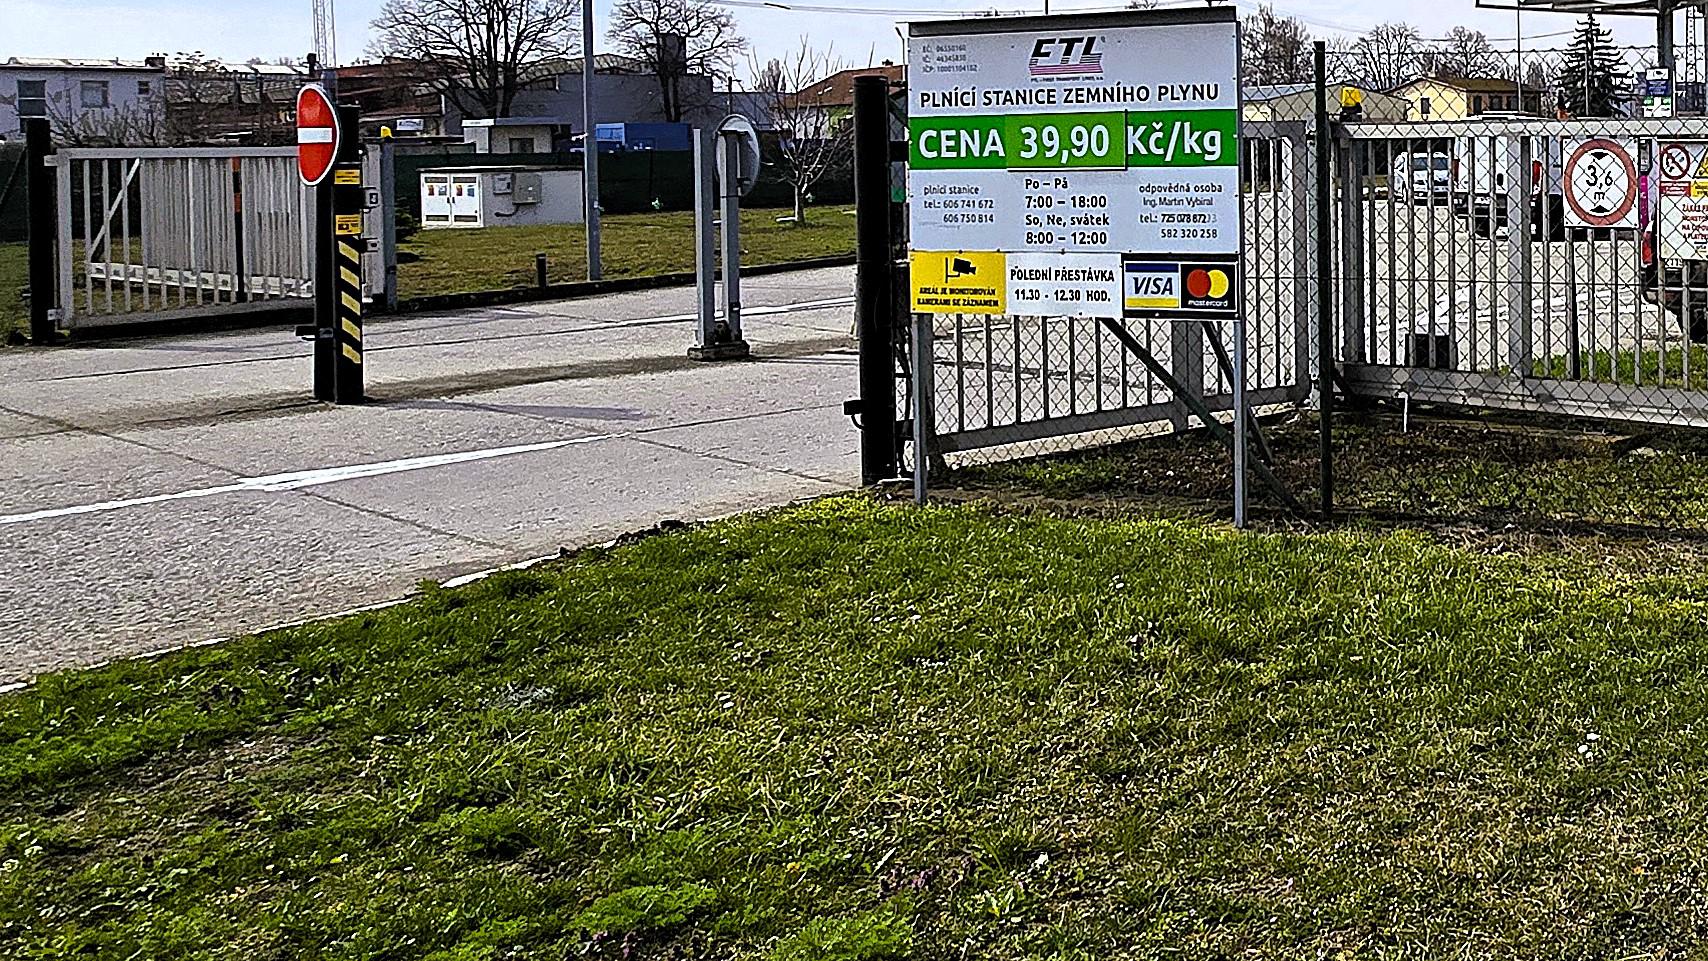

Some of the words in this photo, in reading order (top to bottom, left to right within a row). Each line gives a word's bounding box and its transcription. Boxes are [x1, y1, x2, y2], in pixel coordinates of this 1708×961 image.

[920, 87, 977, 108] PLNÍCÍ
[982, 89, 1057, 107] STANICE
[1063, 82, 1151, 104] ZEMNÍHO
[1157, 84, 1219, 102] PLYNU
[918, 128, 1006, 158] CENA
[1019, 125, 1110, 164] 39,90
[1127, 120, 1222, 161] Kč/kg
[1025, 178, 1040, 190] Po
[1054, 176, 1068, 189] Pá
[1585, 164, 1614, 190] 3,6
[948, 185, 980, 195] stanice
[1139, 182, 1191, 195] odpovědná
[1193, 182, 1223, 193] osoba
[1593, 191, 1606, 200] m
[943, 199, 959, 209] 606
[960, 199, 976, 209] 741
[978, 199, 994, 209] 672
[1025, 195, 1053, 209] 7:00
[1070, 195, 1107, 208] 18:00
[1143, 197, 1157, 208] Ing.
[1158, 196, 1184, 206] Martin
[943, 214, 959, 223] 606
[960, 214, 977, 223] 750
[978, 214, 994, 223] 814
[1025, 214, 1043, 227] So,
[1047, 215, 1067, 227] Ne,
[1070, 213, 1110, 226] svátek
[1025, 231, 1053, 245] 8:00
[1070, 231, 1107, 245] 12:00
[1160, 228, 1178, 238] 582
[1180, 228, 1198, 238] 320
[1199, 228, 1218, 239] 258
[1010, 266, 1052, 281] POLEDNÍ
[1054, 266, 1115, 282] PŘESTÁVKA
[1132, 276, 1174, 296] VISA
[1014, 289, 1040, 301] 11.30
[1054, 289, 1081, 302] 12.30
[1086, 289, 1111, 302] HOD.
